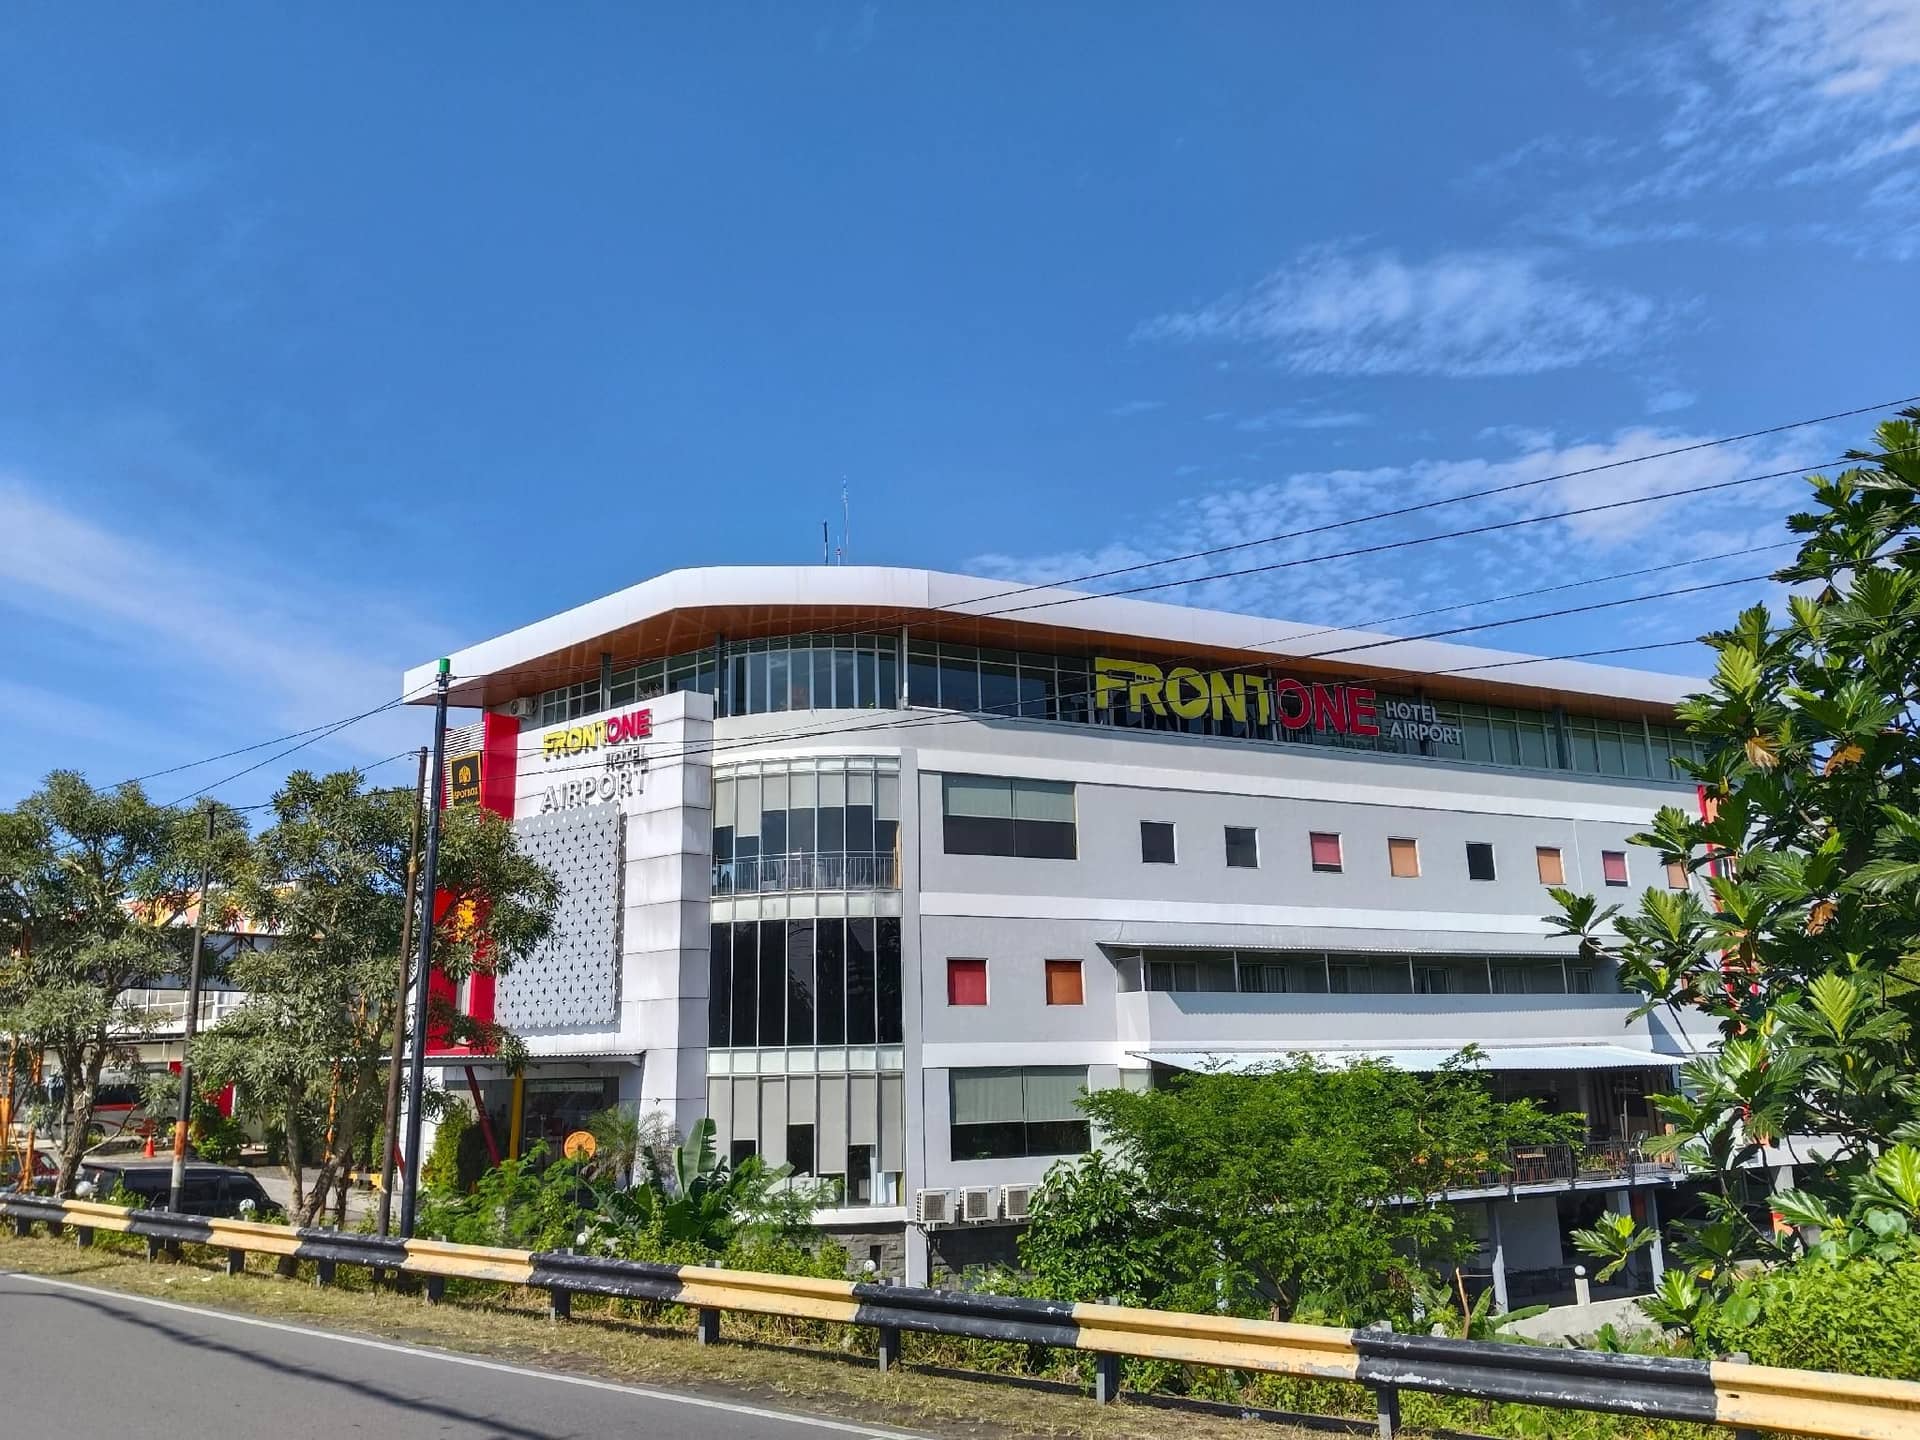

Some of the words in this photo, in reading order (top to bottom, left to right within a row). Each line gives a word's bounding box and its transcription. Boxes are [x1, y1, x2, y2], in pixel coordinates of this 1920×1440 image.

[1385, 700, 1442, 723] HOTEL
[1390, 721, 1462, 746] AIRPORT
[605, 746, 648, 771] HOTEL
[540, 763, 648, 813] AIRPORT
